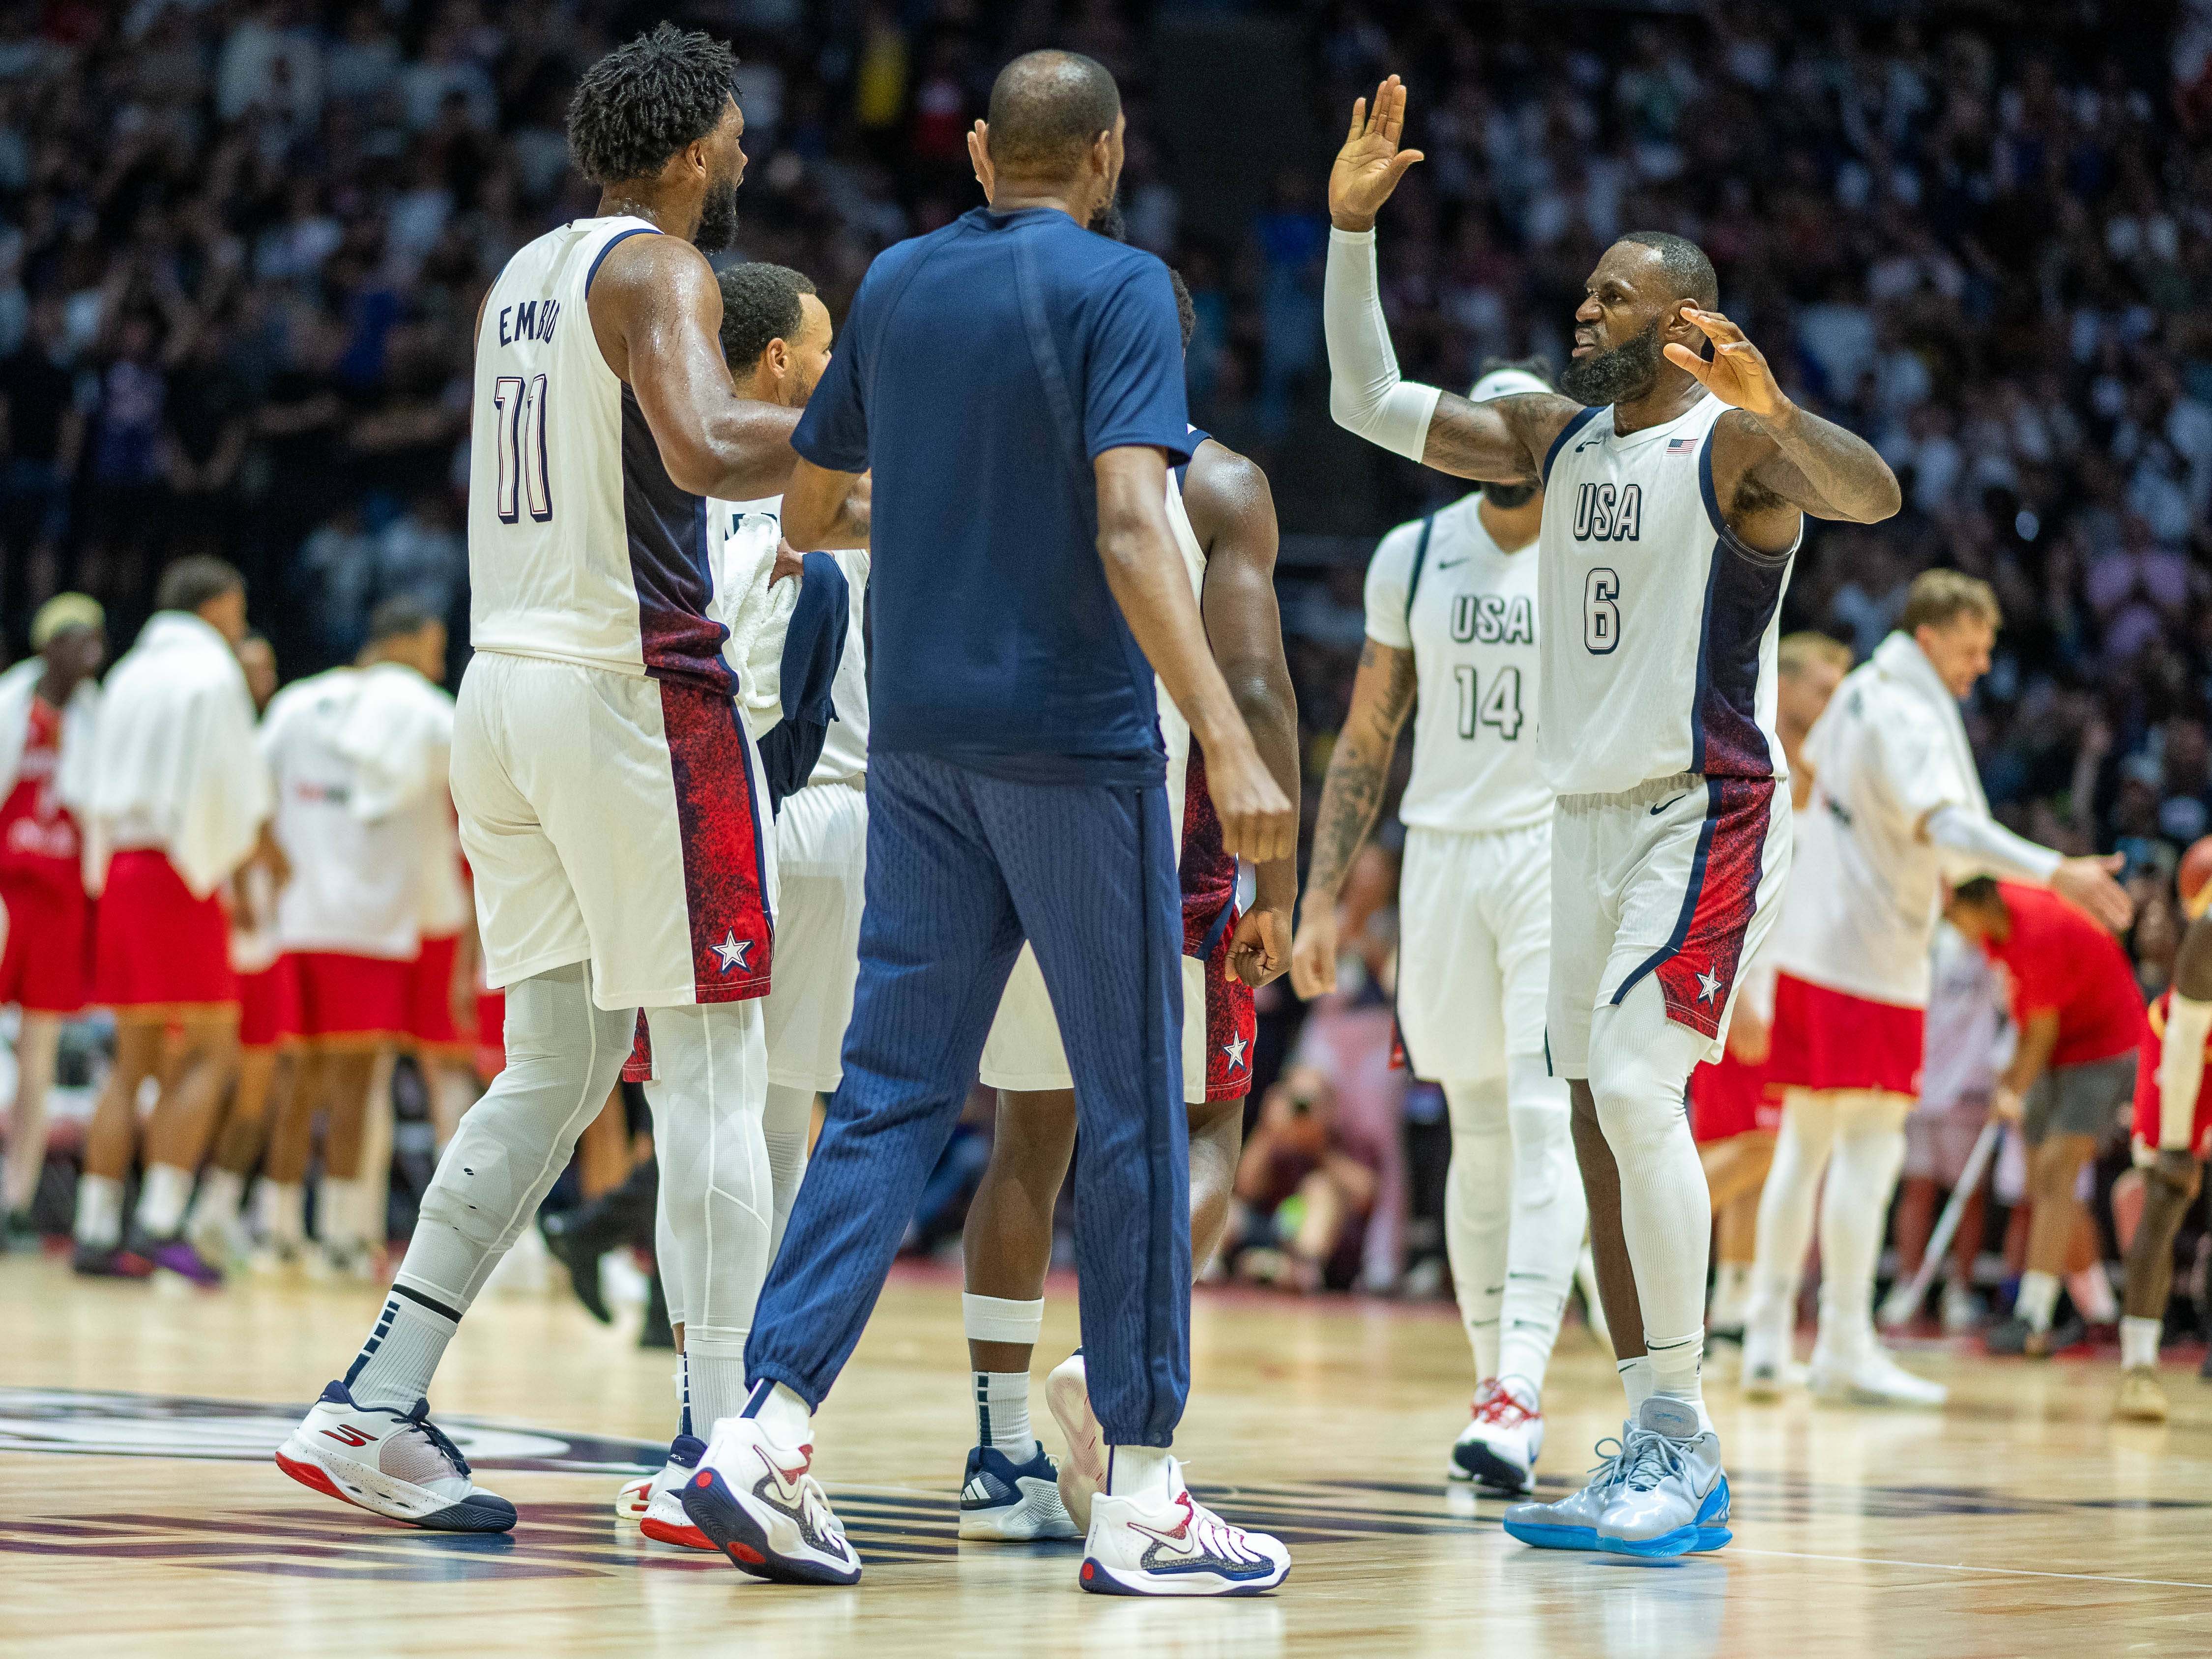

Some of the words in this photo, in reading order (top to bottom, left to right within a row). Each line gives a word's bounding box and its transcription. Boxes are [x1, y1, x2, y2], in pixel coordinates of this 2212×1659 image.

[494, 373, 553, 525] 11
[1573, 483, 1642, 541] USA
[1451, 594, 1533, 645] USA
[1583, 567, 1621, 655] 6
[1453, 665, 1524, 741] 14
